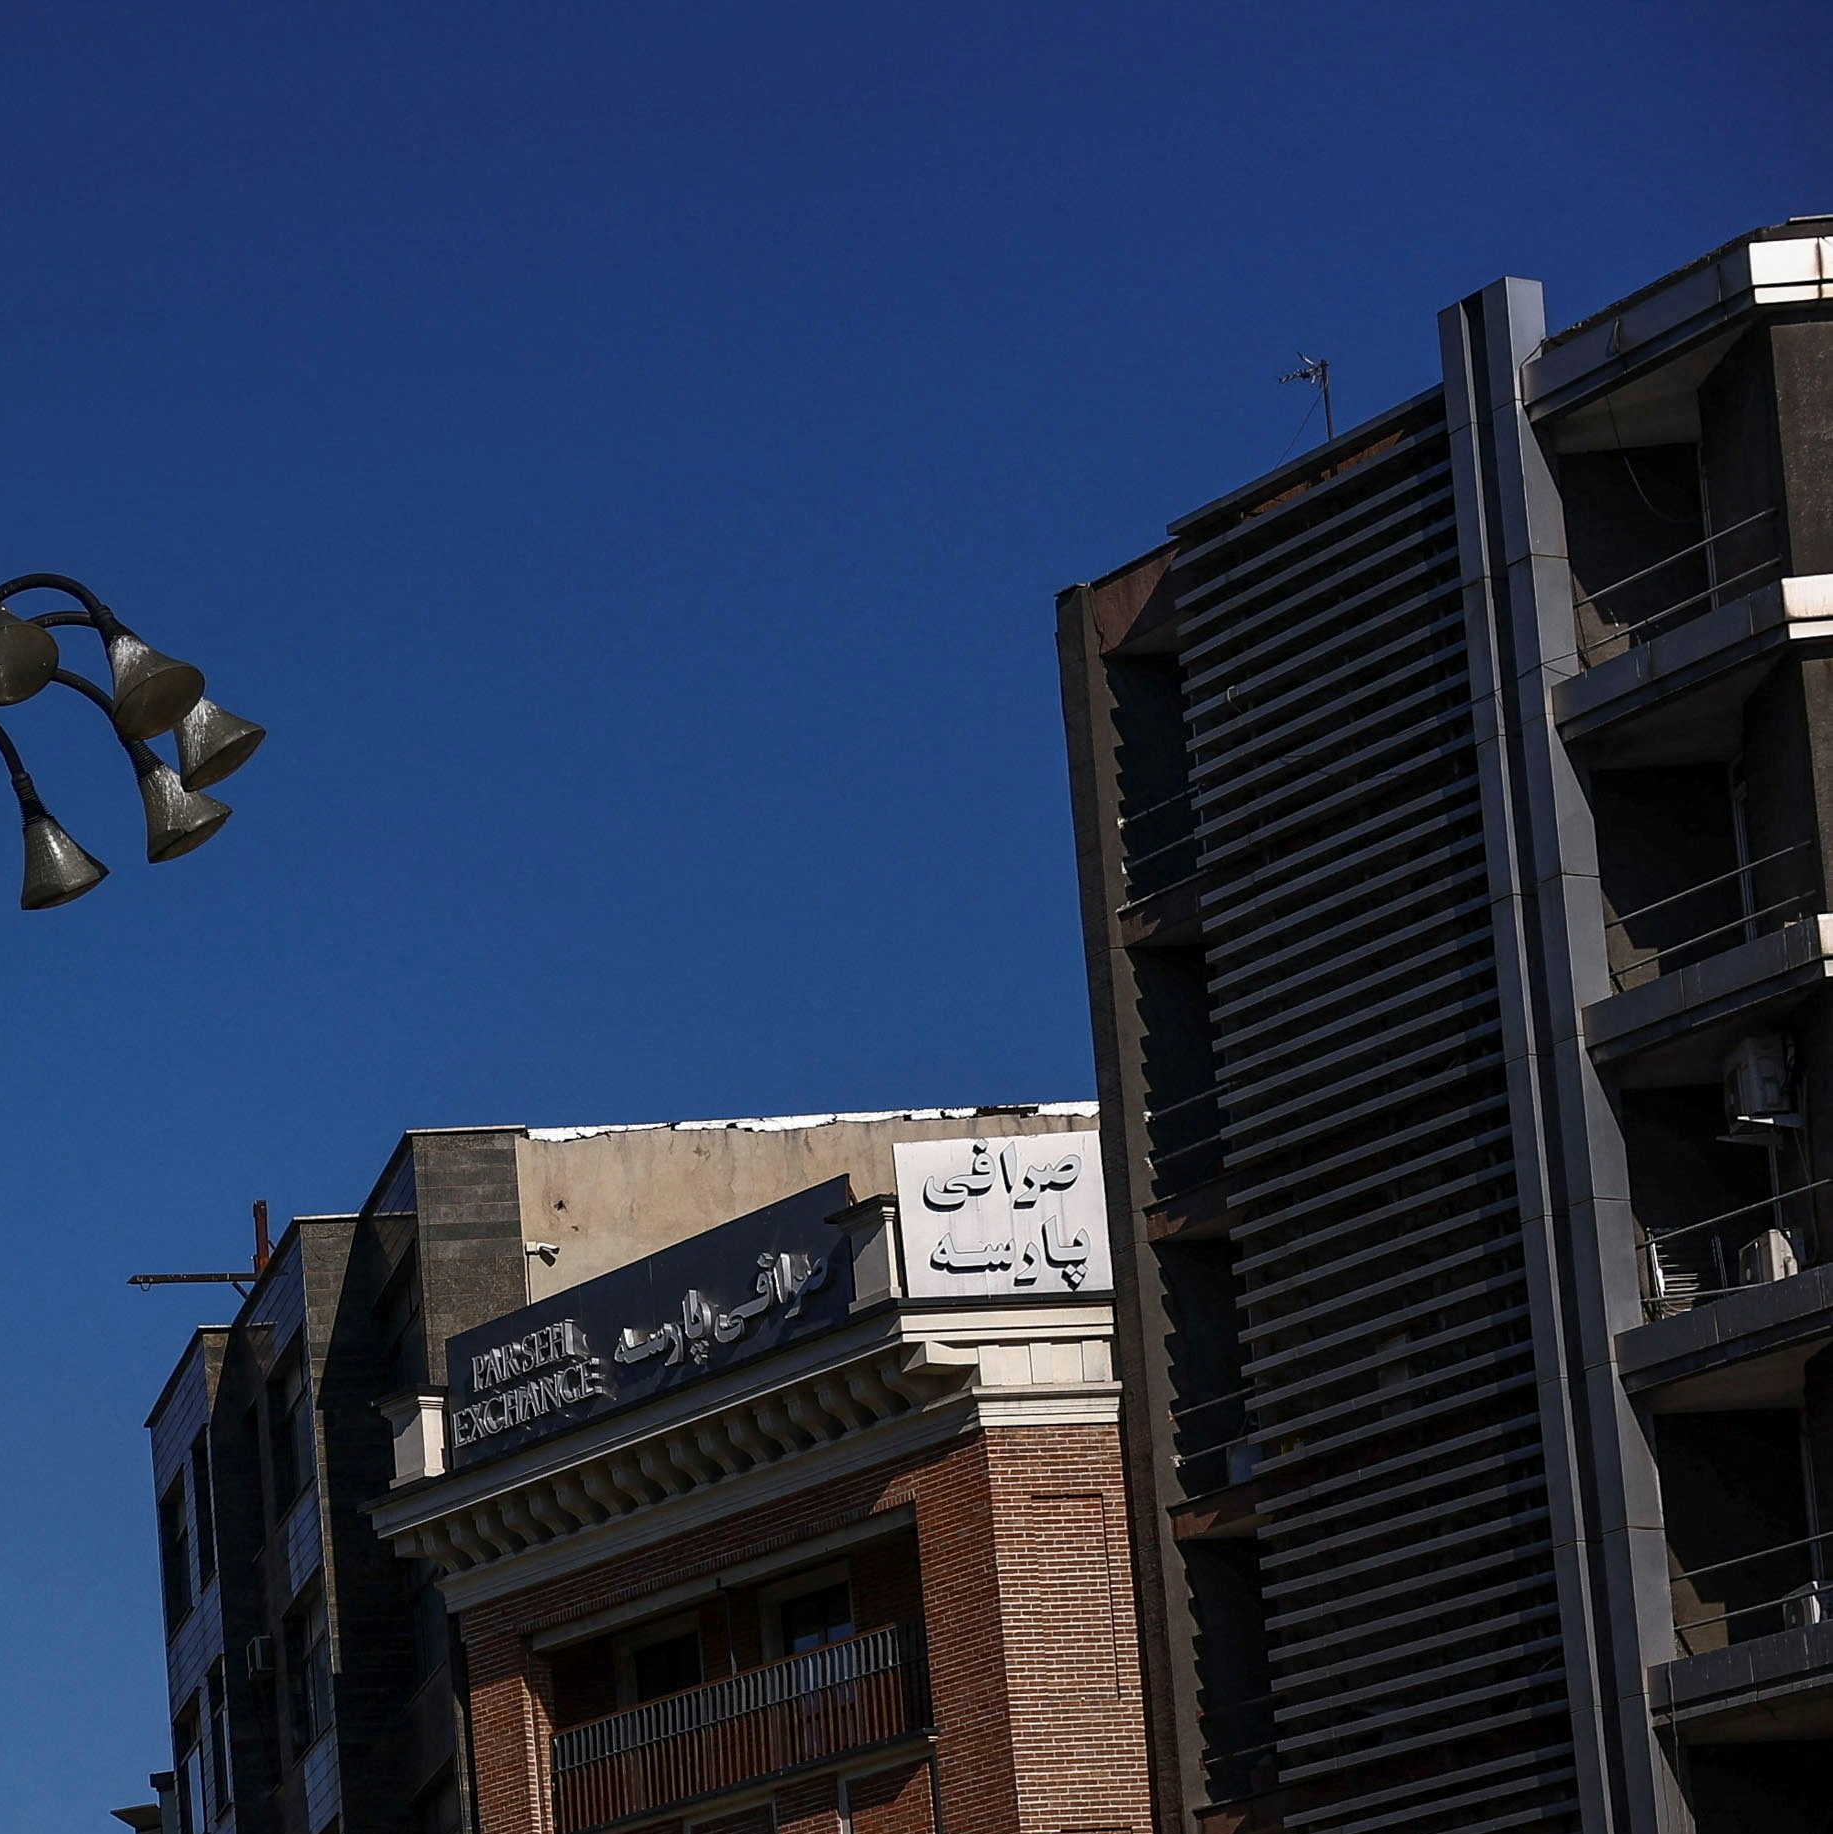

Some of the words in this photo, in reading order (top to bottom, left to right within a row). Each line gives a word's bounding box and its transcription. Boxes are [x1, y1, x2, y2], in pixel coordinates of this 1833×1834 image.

[923, 1138, 1082, 1212] صرافی
[930, 1215, 1091, 1291] پارسه
[614, 1289, 713, 1367] پارسه
[714, 1251, 827, 1342] صرافی
[471, 1318, 589, 1393] PARSEH
[452, 1357, 605, 1449] EXCHANGE
